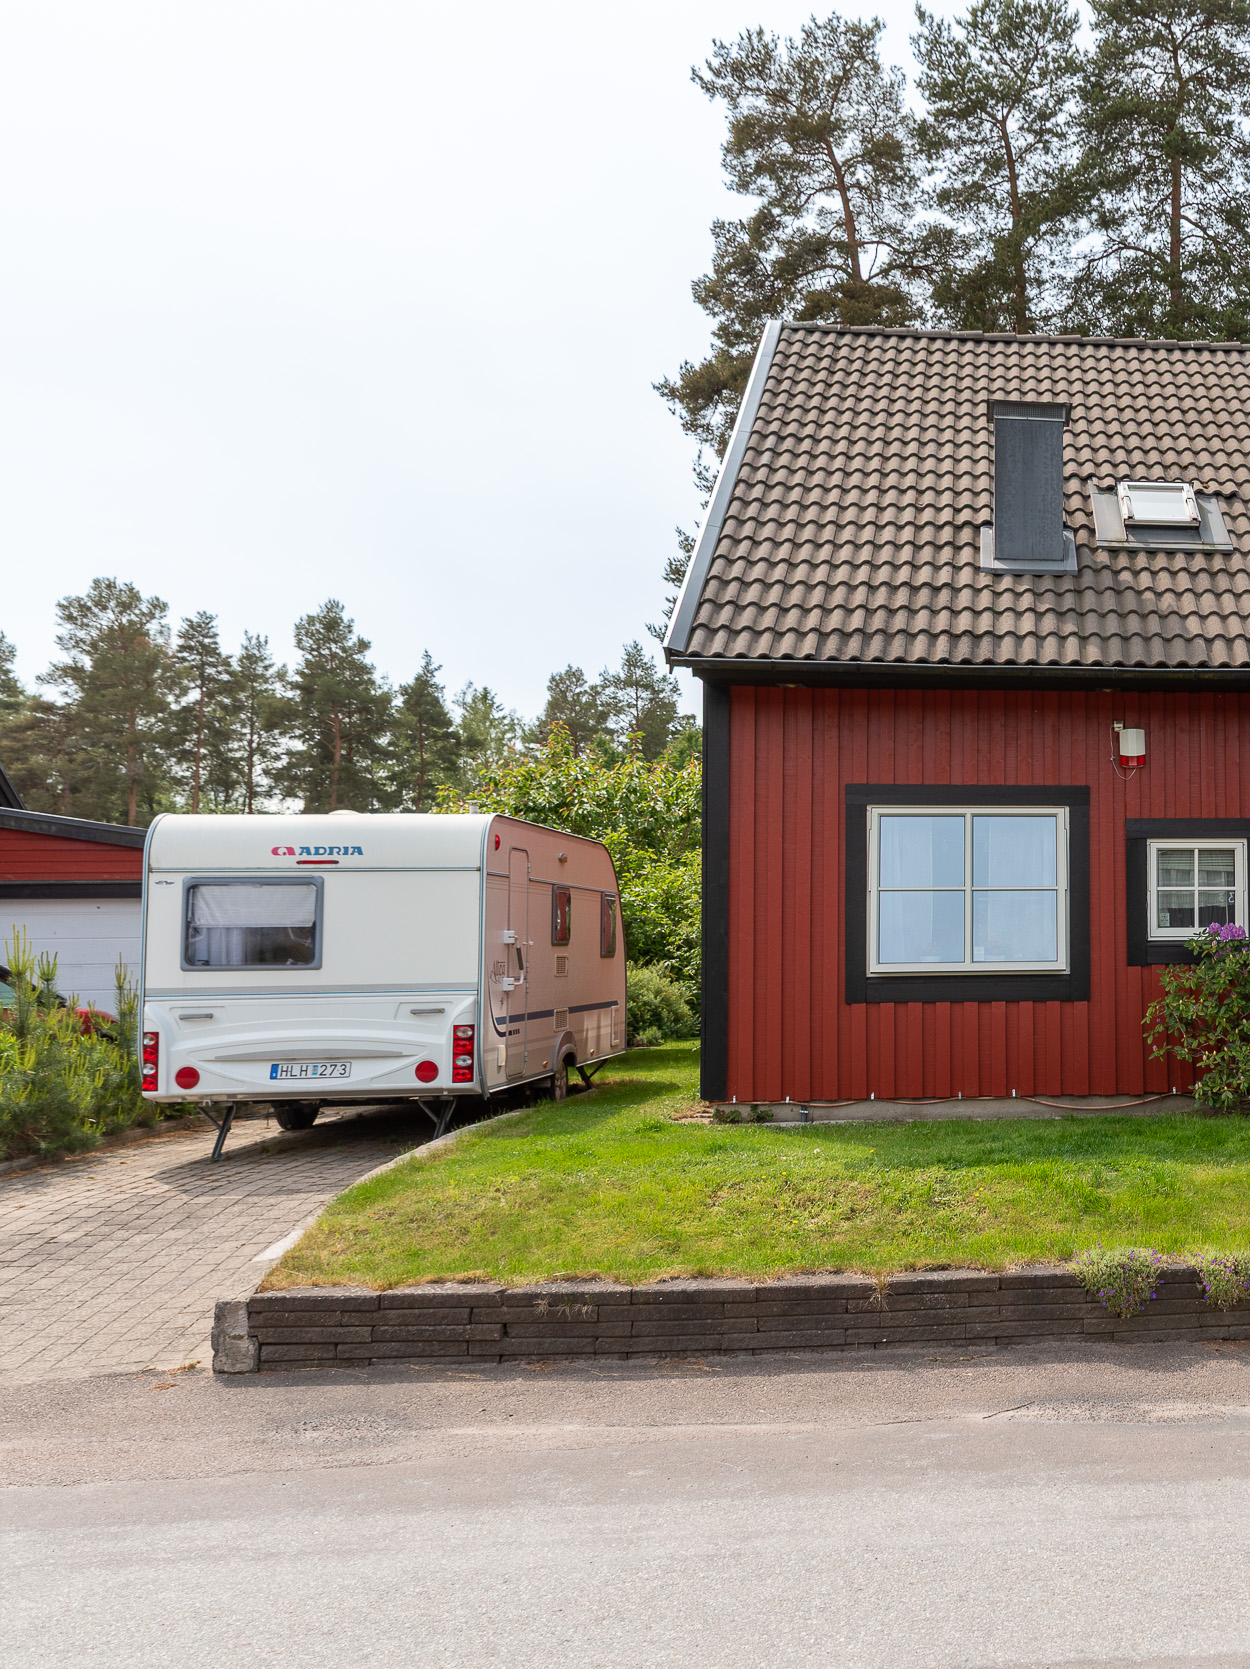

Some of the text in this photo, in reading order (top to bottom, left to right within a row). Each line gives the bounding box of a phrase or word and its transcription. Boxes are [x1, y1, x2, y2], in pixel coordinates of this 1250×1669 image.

[299, 846, 364, 856] ADRIA
[280, 1065, 309, 1077] HLH
[319, 1064, 347, 1076] 273
